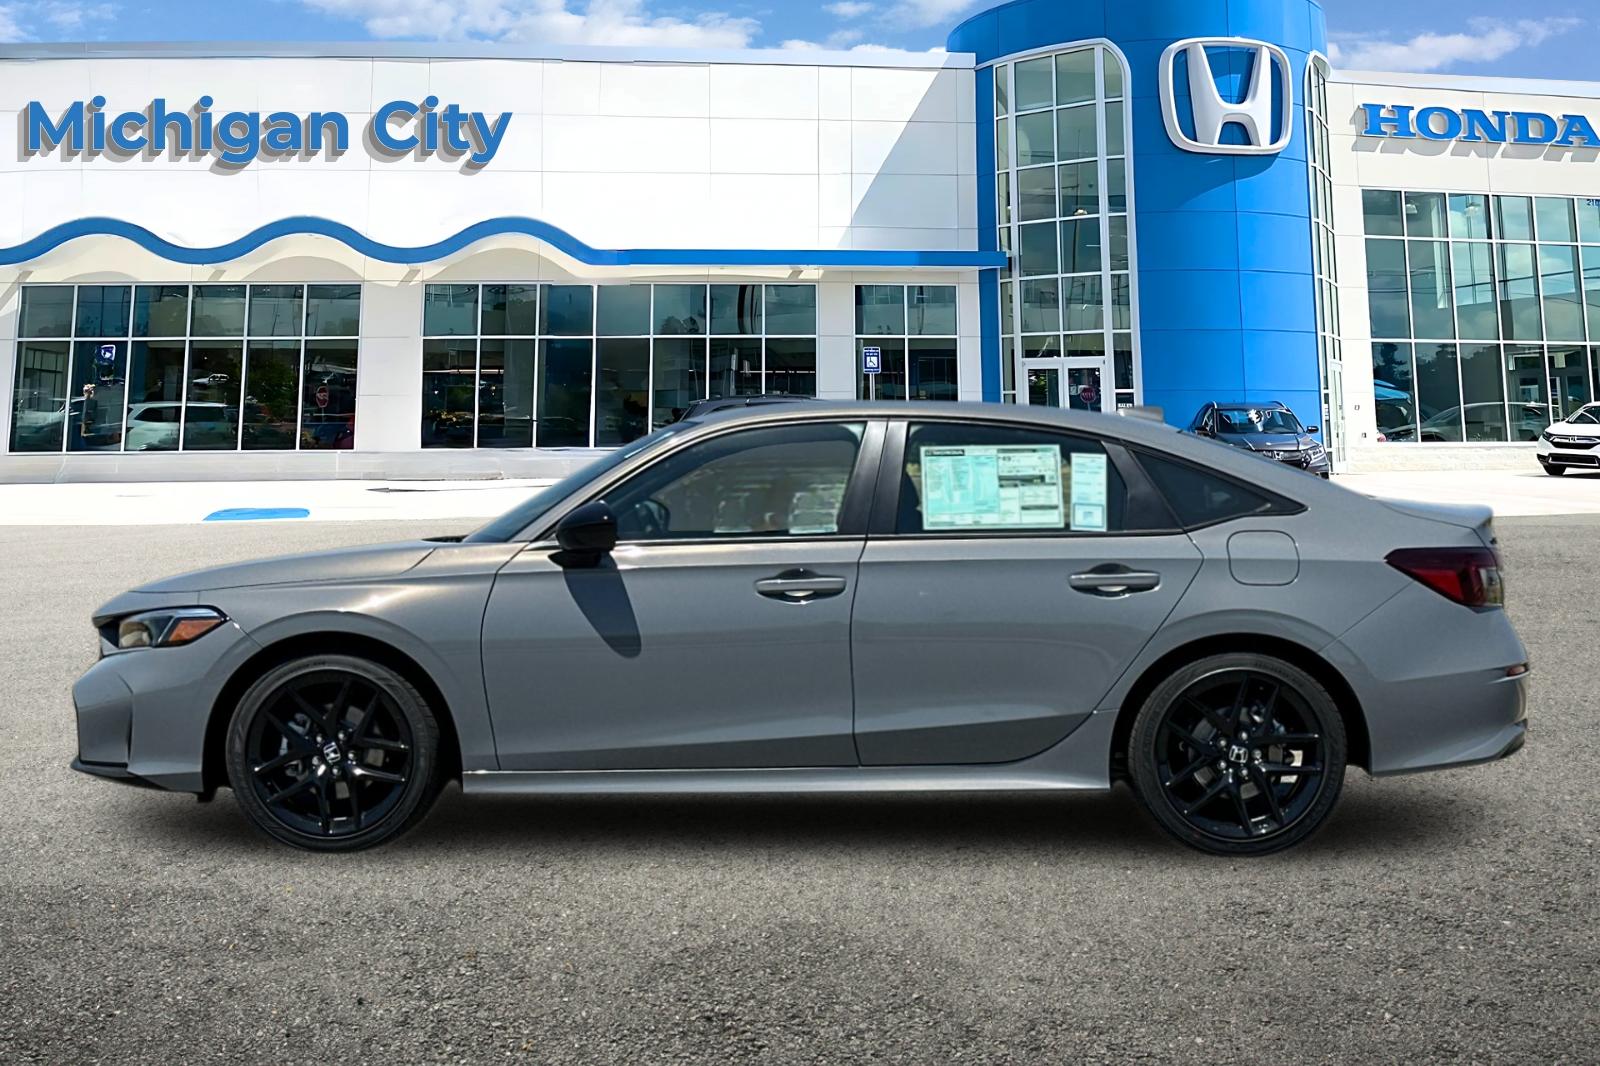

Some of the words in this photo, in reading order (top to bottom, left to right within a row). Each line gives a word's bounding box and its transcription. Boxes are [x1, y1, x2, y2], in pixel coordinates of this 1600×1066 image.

[27, 95, 350, 164] Michigan
[373, 95, 513, 164] City
[1361, 103, 1600, 148] HONDA
